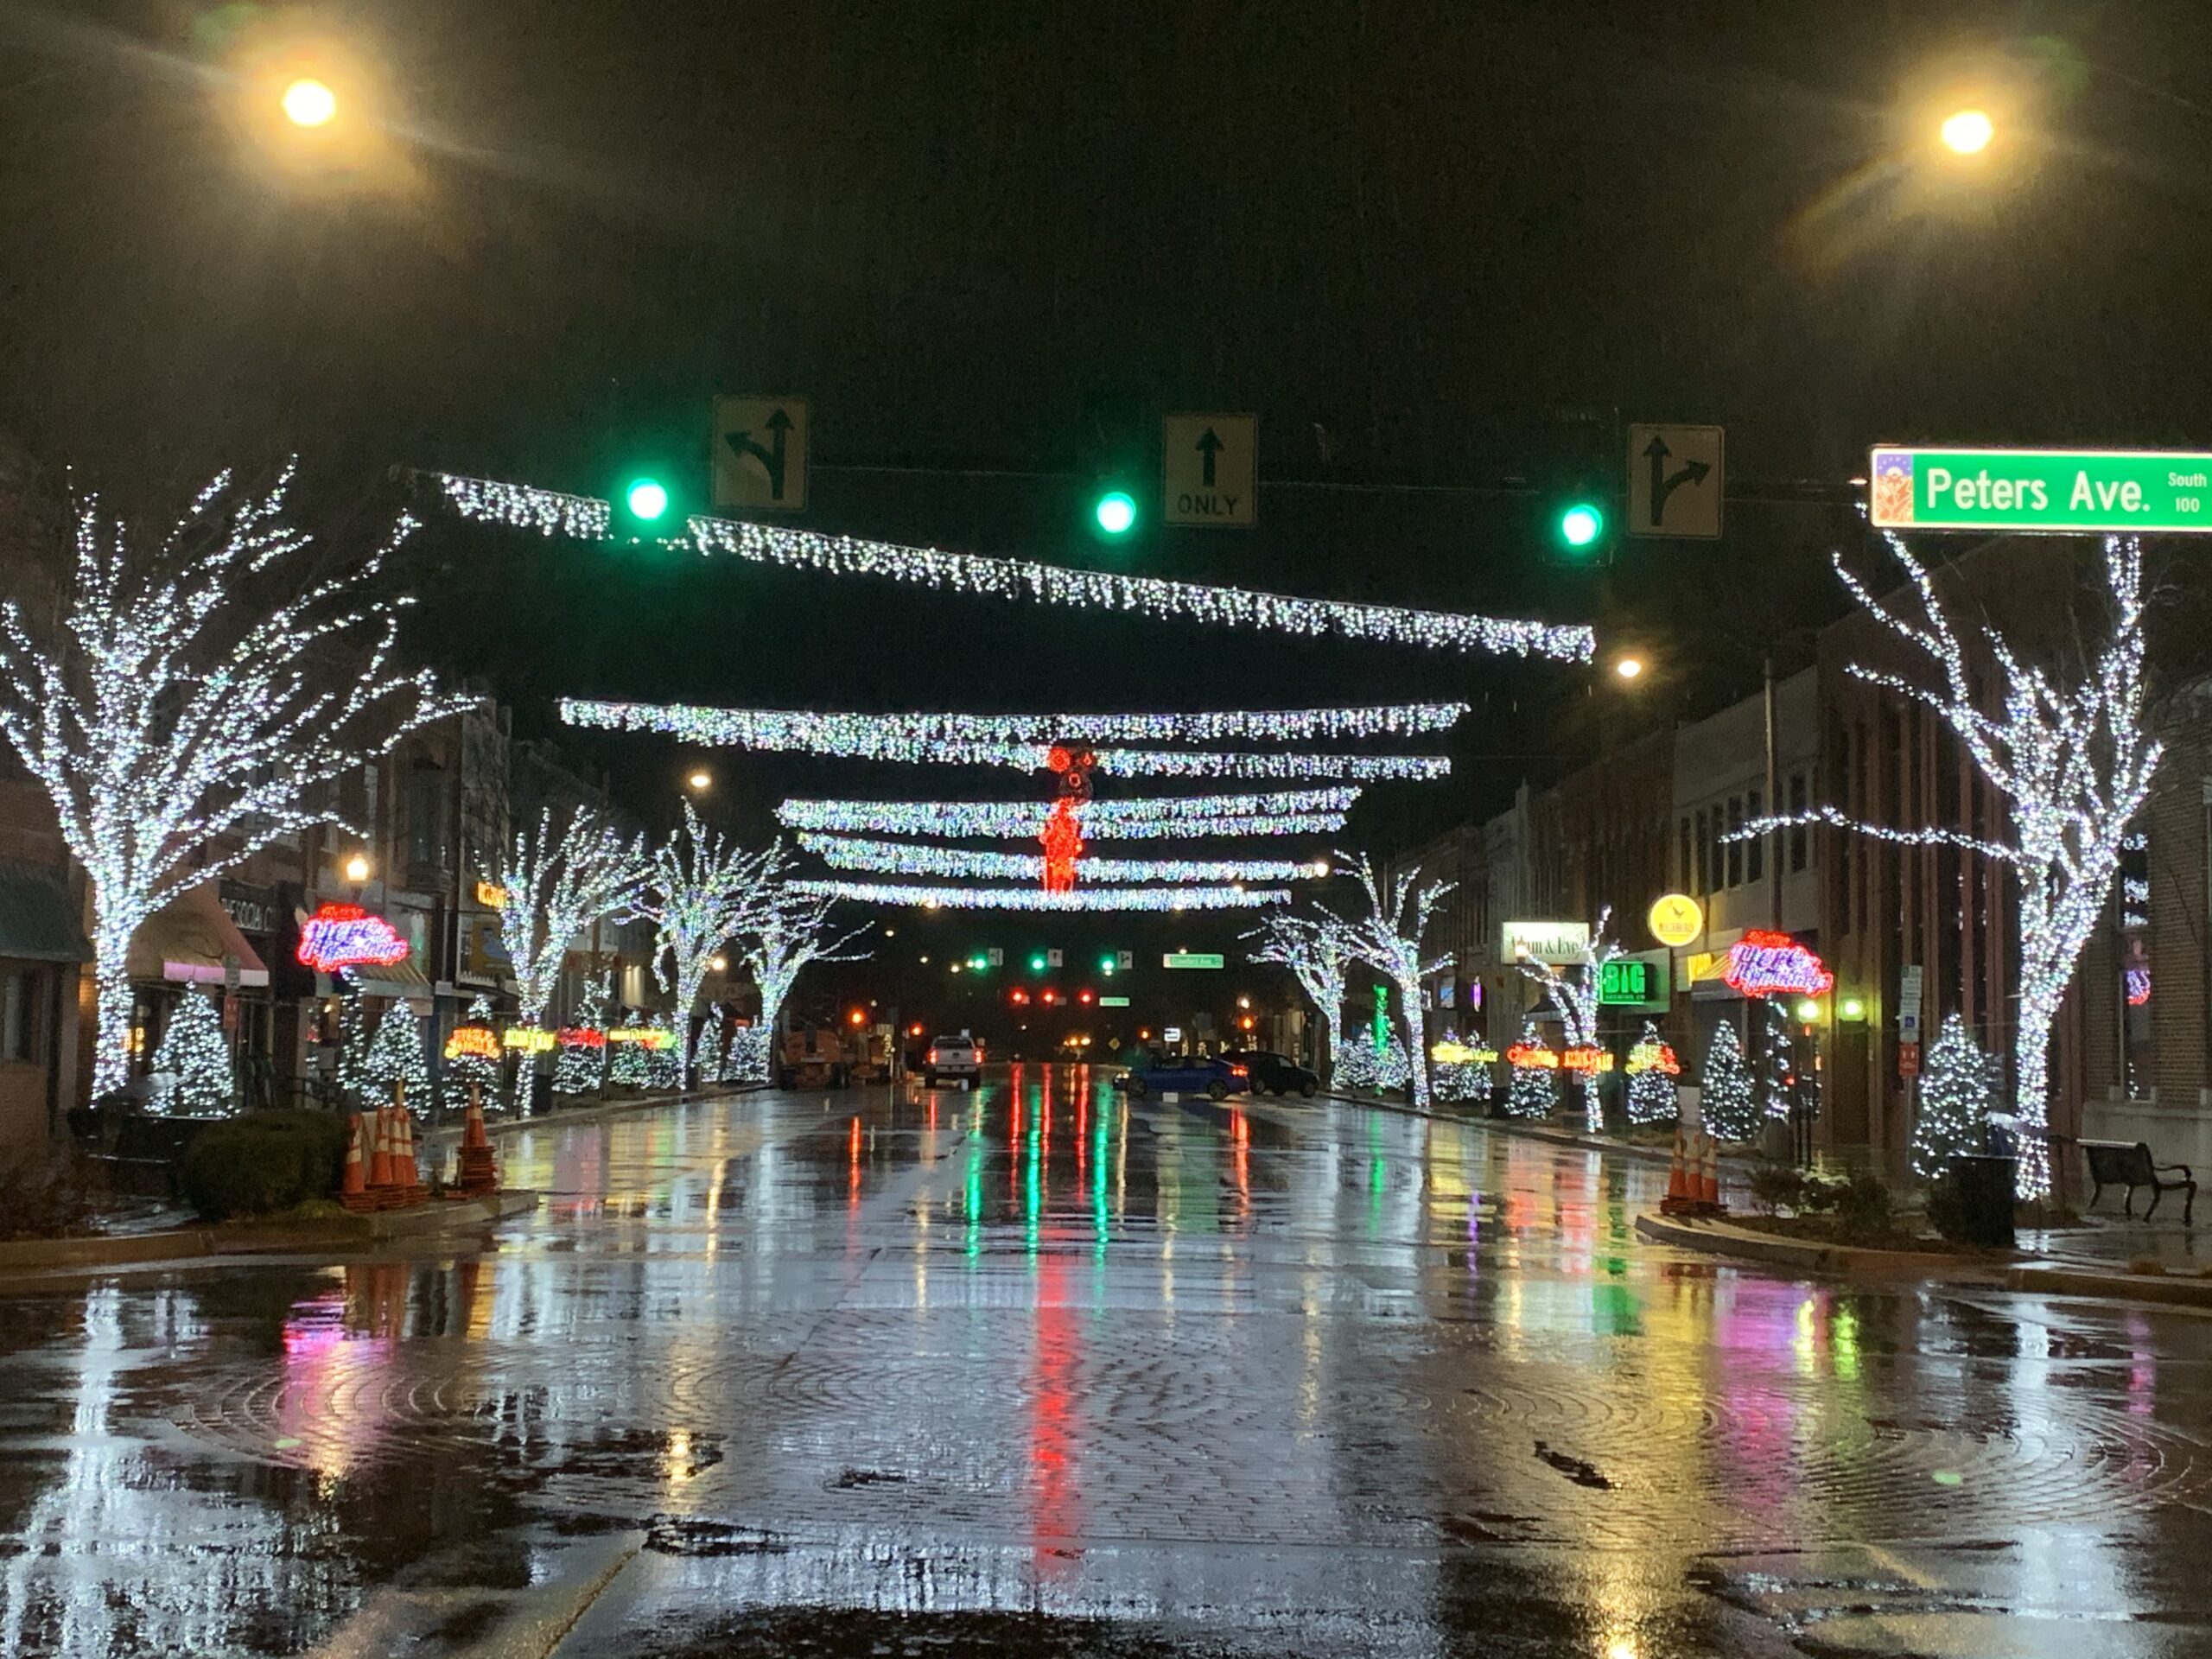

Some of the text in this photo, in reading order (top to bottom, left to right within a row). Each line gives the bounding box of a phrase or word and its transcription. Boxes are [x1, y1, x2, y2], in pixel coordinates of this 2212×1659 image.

[2168, 472, 2207, 487] South
[1928, 467, 2151, 512] Peters Ave.
[1178, 495, 1237, 515] ONLY
[2176, 497, 2200, 512] 100
[1545, 938, 1554, 954] &
[1557, 936, 1579, 955] Eve
[1605, 964, 1646, 994] BIG
